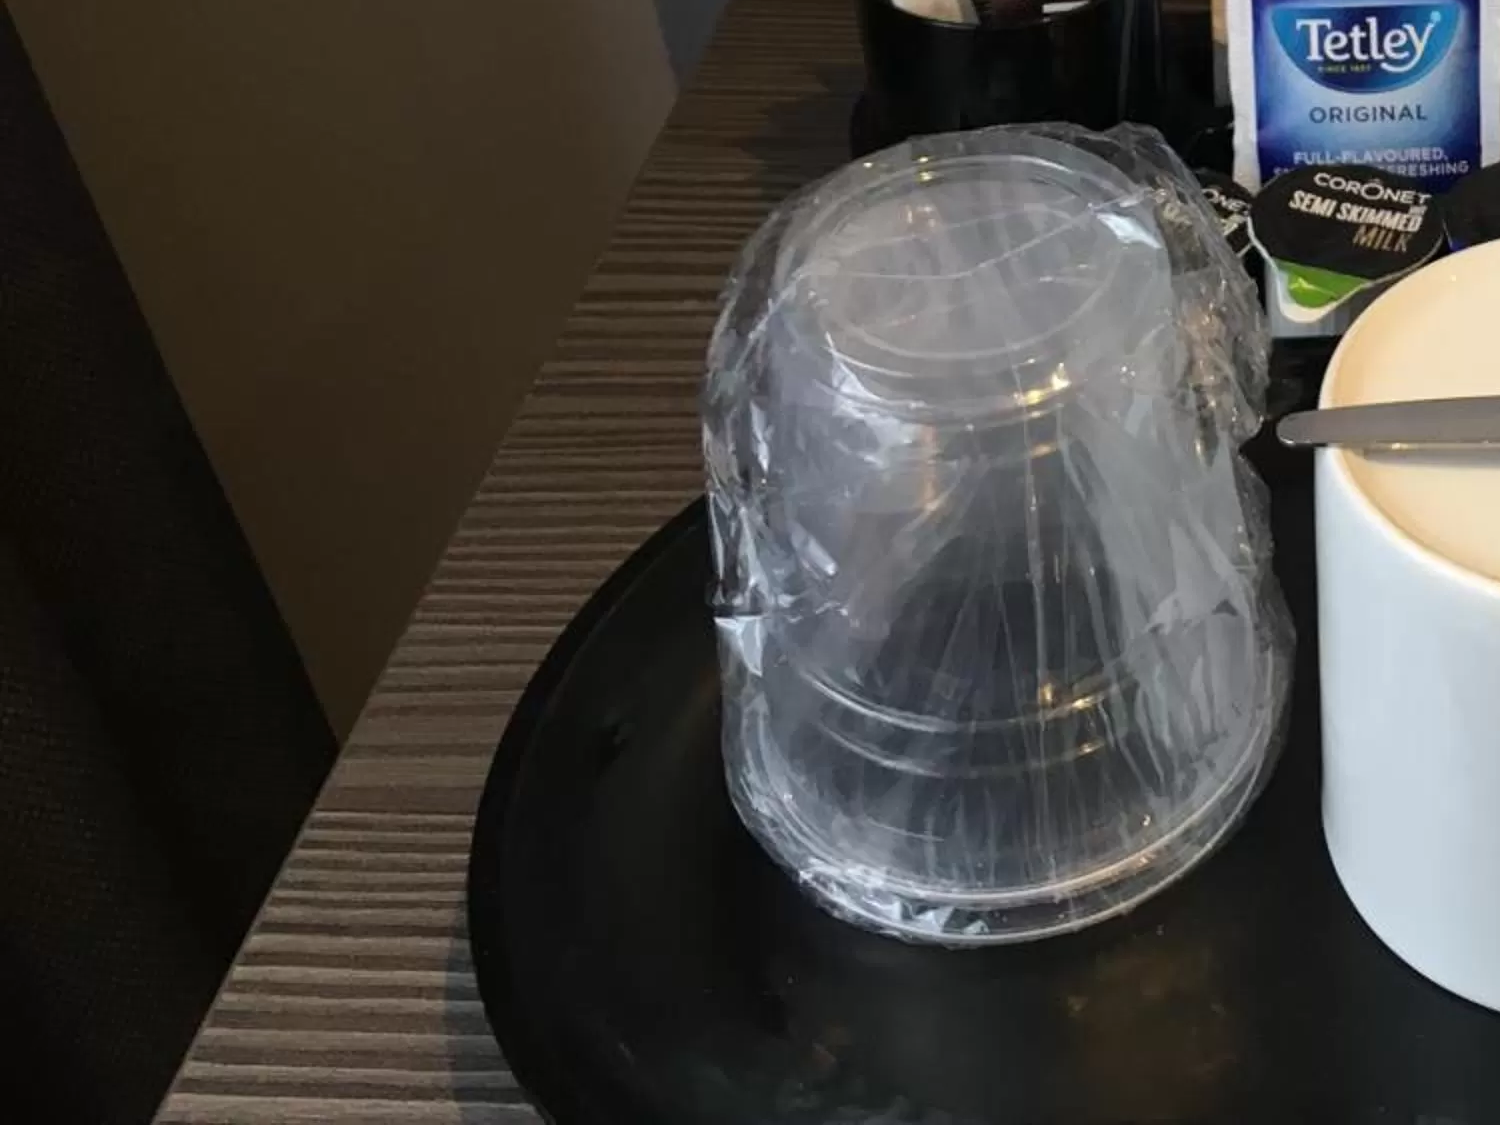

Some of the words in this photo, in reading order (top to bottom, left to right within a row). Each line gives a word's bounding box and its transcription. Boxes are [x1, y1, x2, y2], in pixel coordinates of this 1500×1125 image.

[1296, 11, 1441, 73] Tetley
[1308, 104, 1428, 124] ORIGINAL
[1313, 172, 1432, 205] CORONET
[1288, 190, 1338, 218] SEMI
[1336, 202, 1424, 232] SKIMMED
[1353, 225, 1413, 253] MILK
